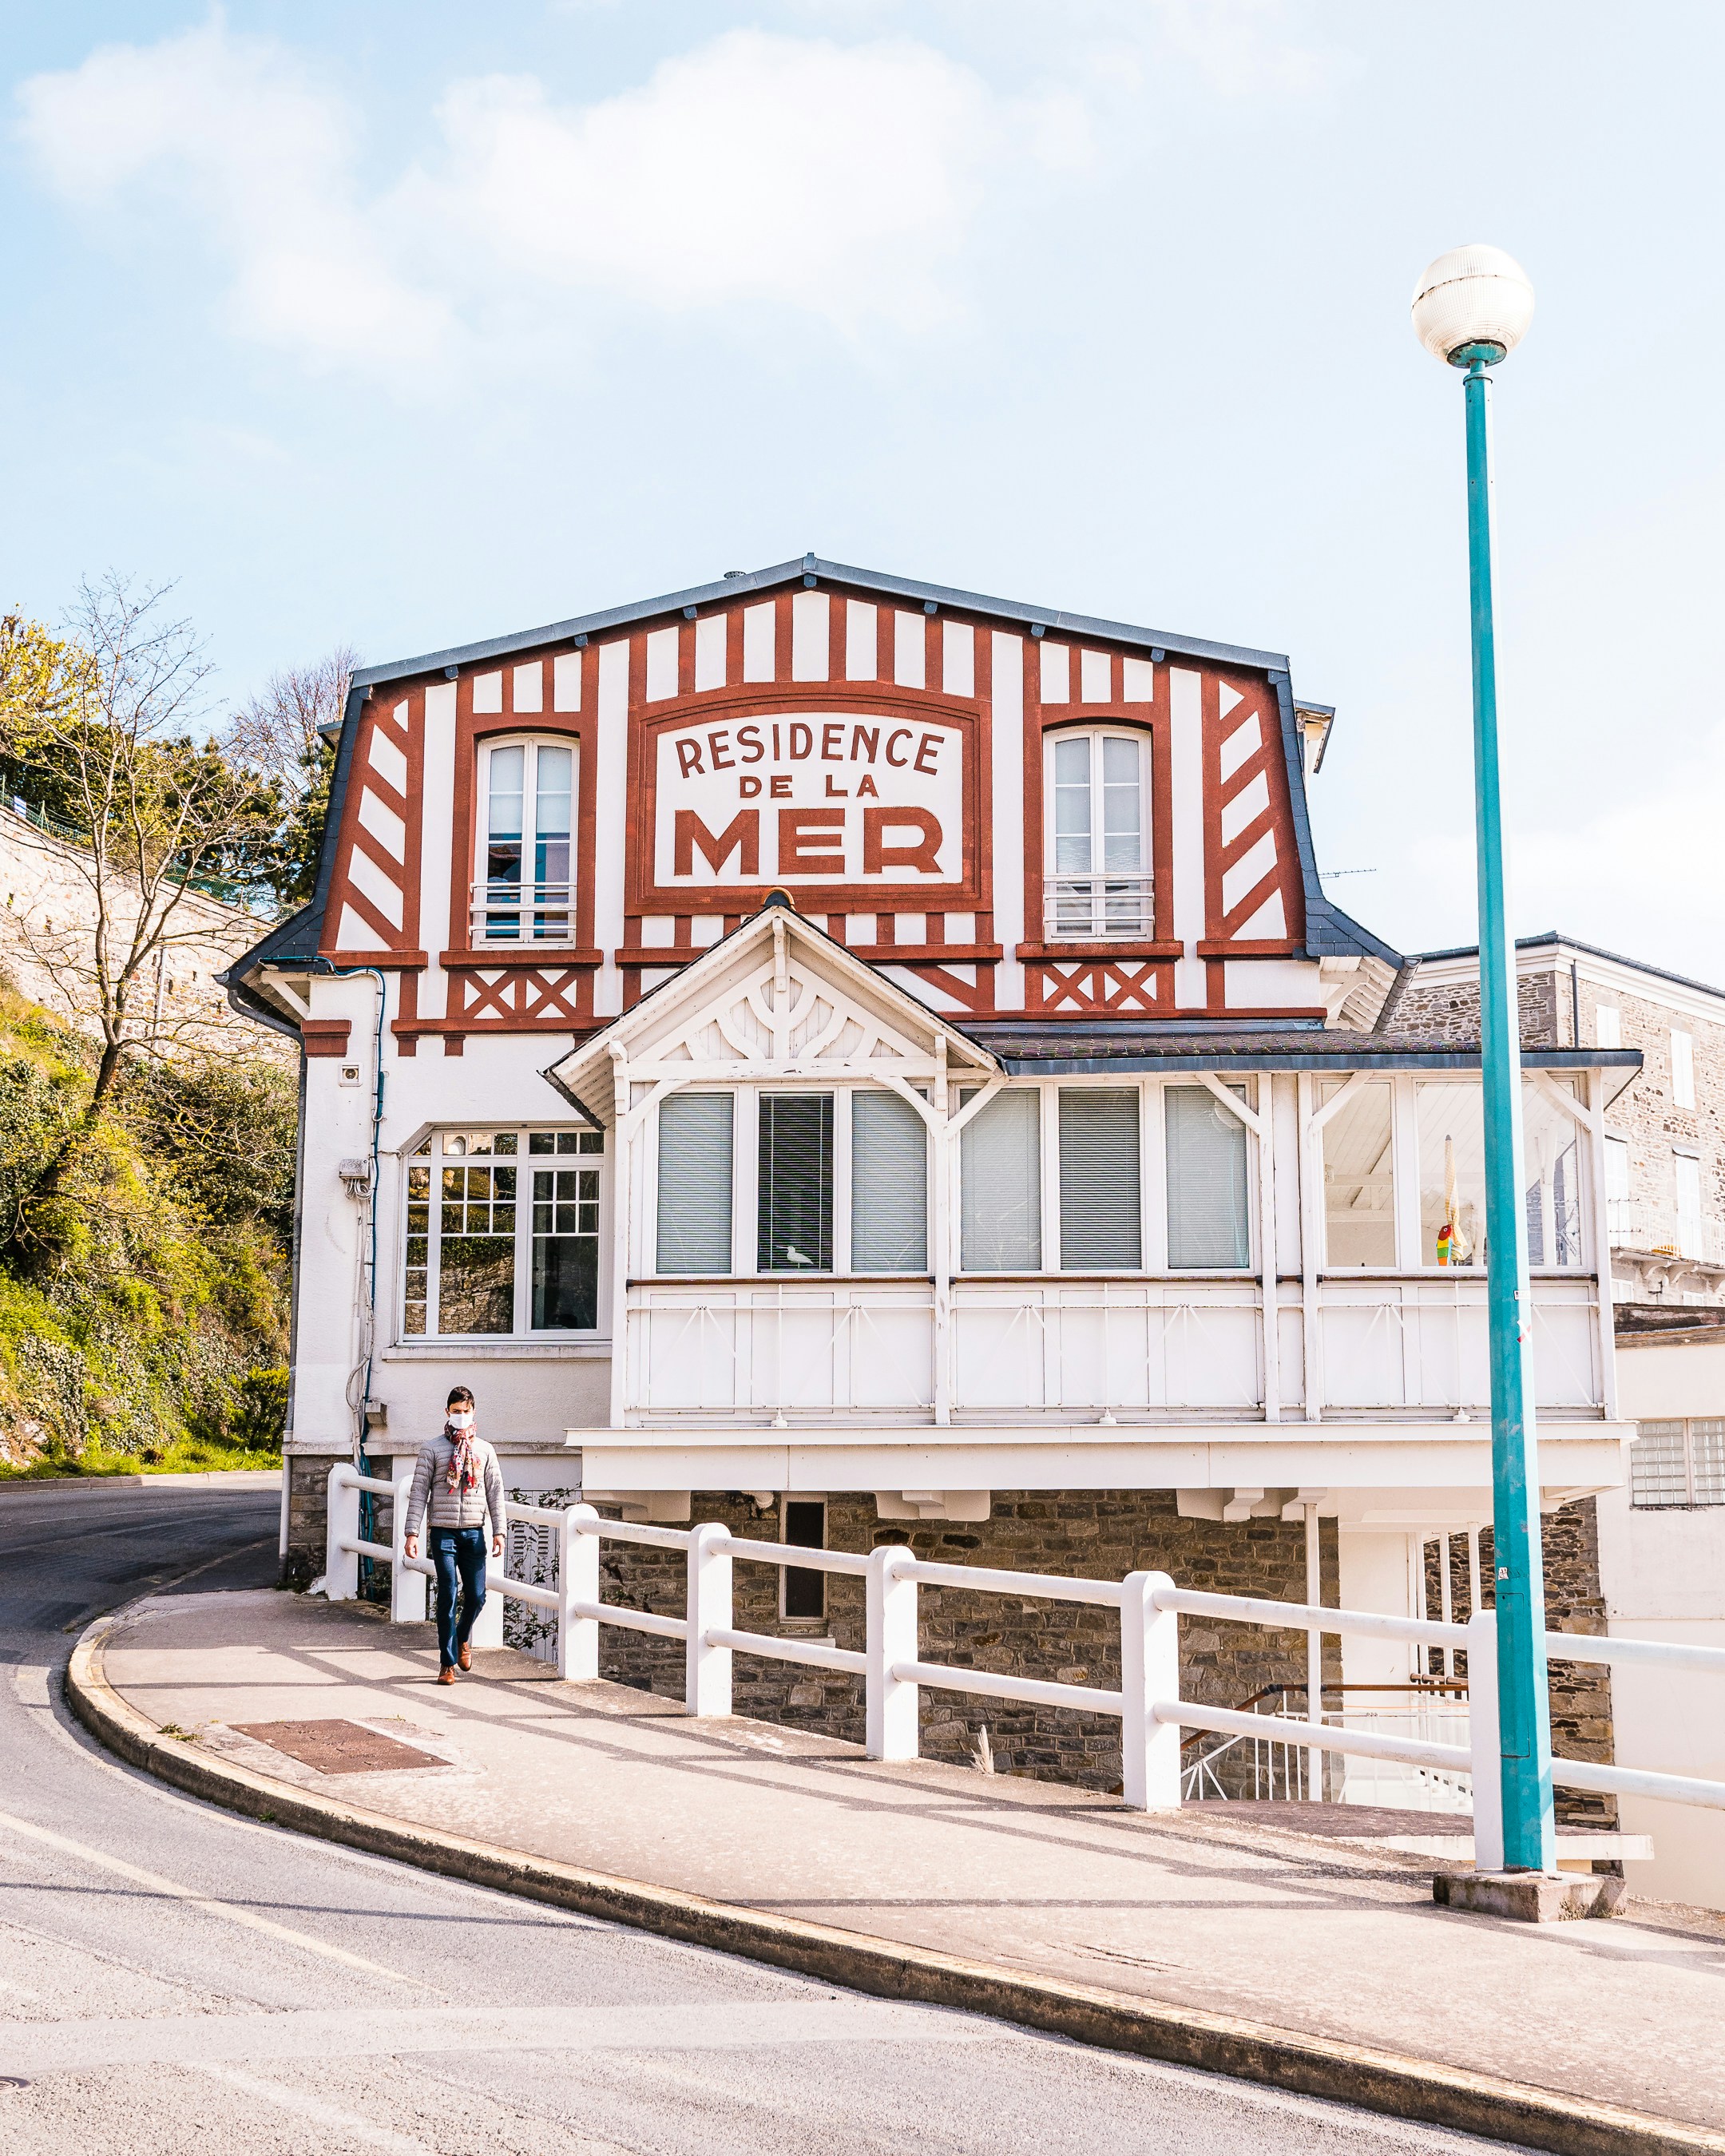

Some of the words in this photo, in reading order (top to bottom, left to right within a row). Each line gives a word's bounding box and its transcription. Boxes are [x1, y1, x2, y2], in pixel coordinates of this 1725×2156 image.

[675, 722, 946, 779] RESIDENCE
[739, 775, 794, 799] DE
[825, 774, 879, 799] LA
[673, 805, 944, 877] MER
